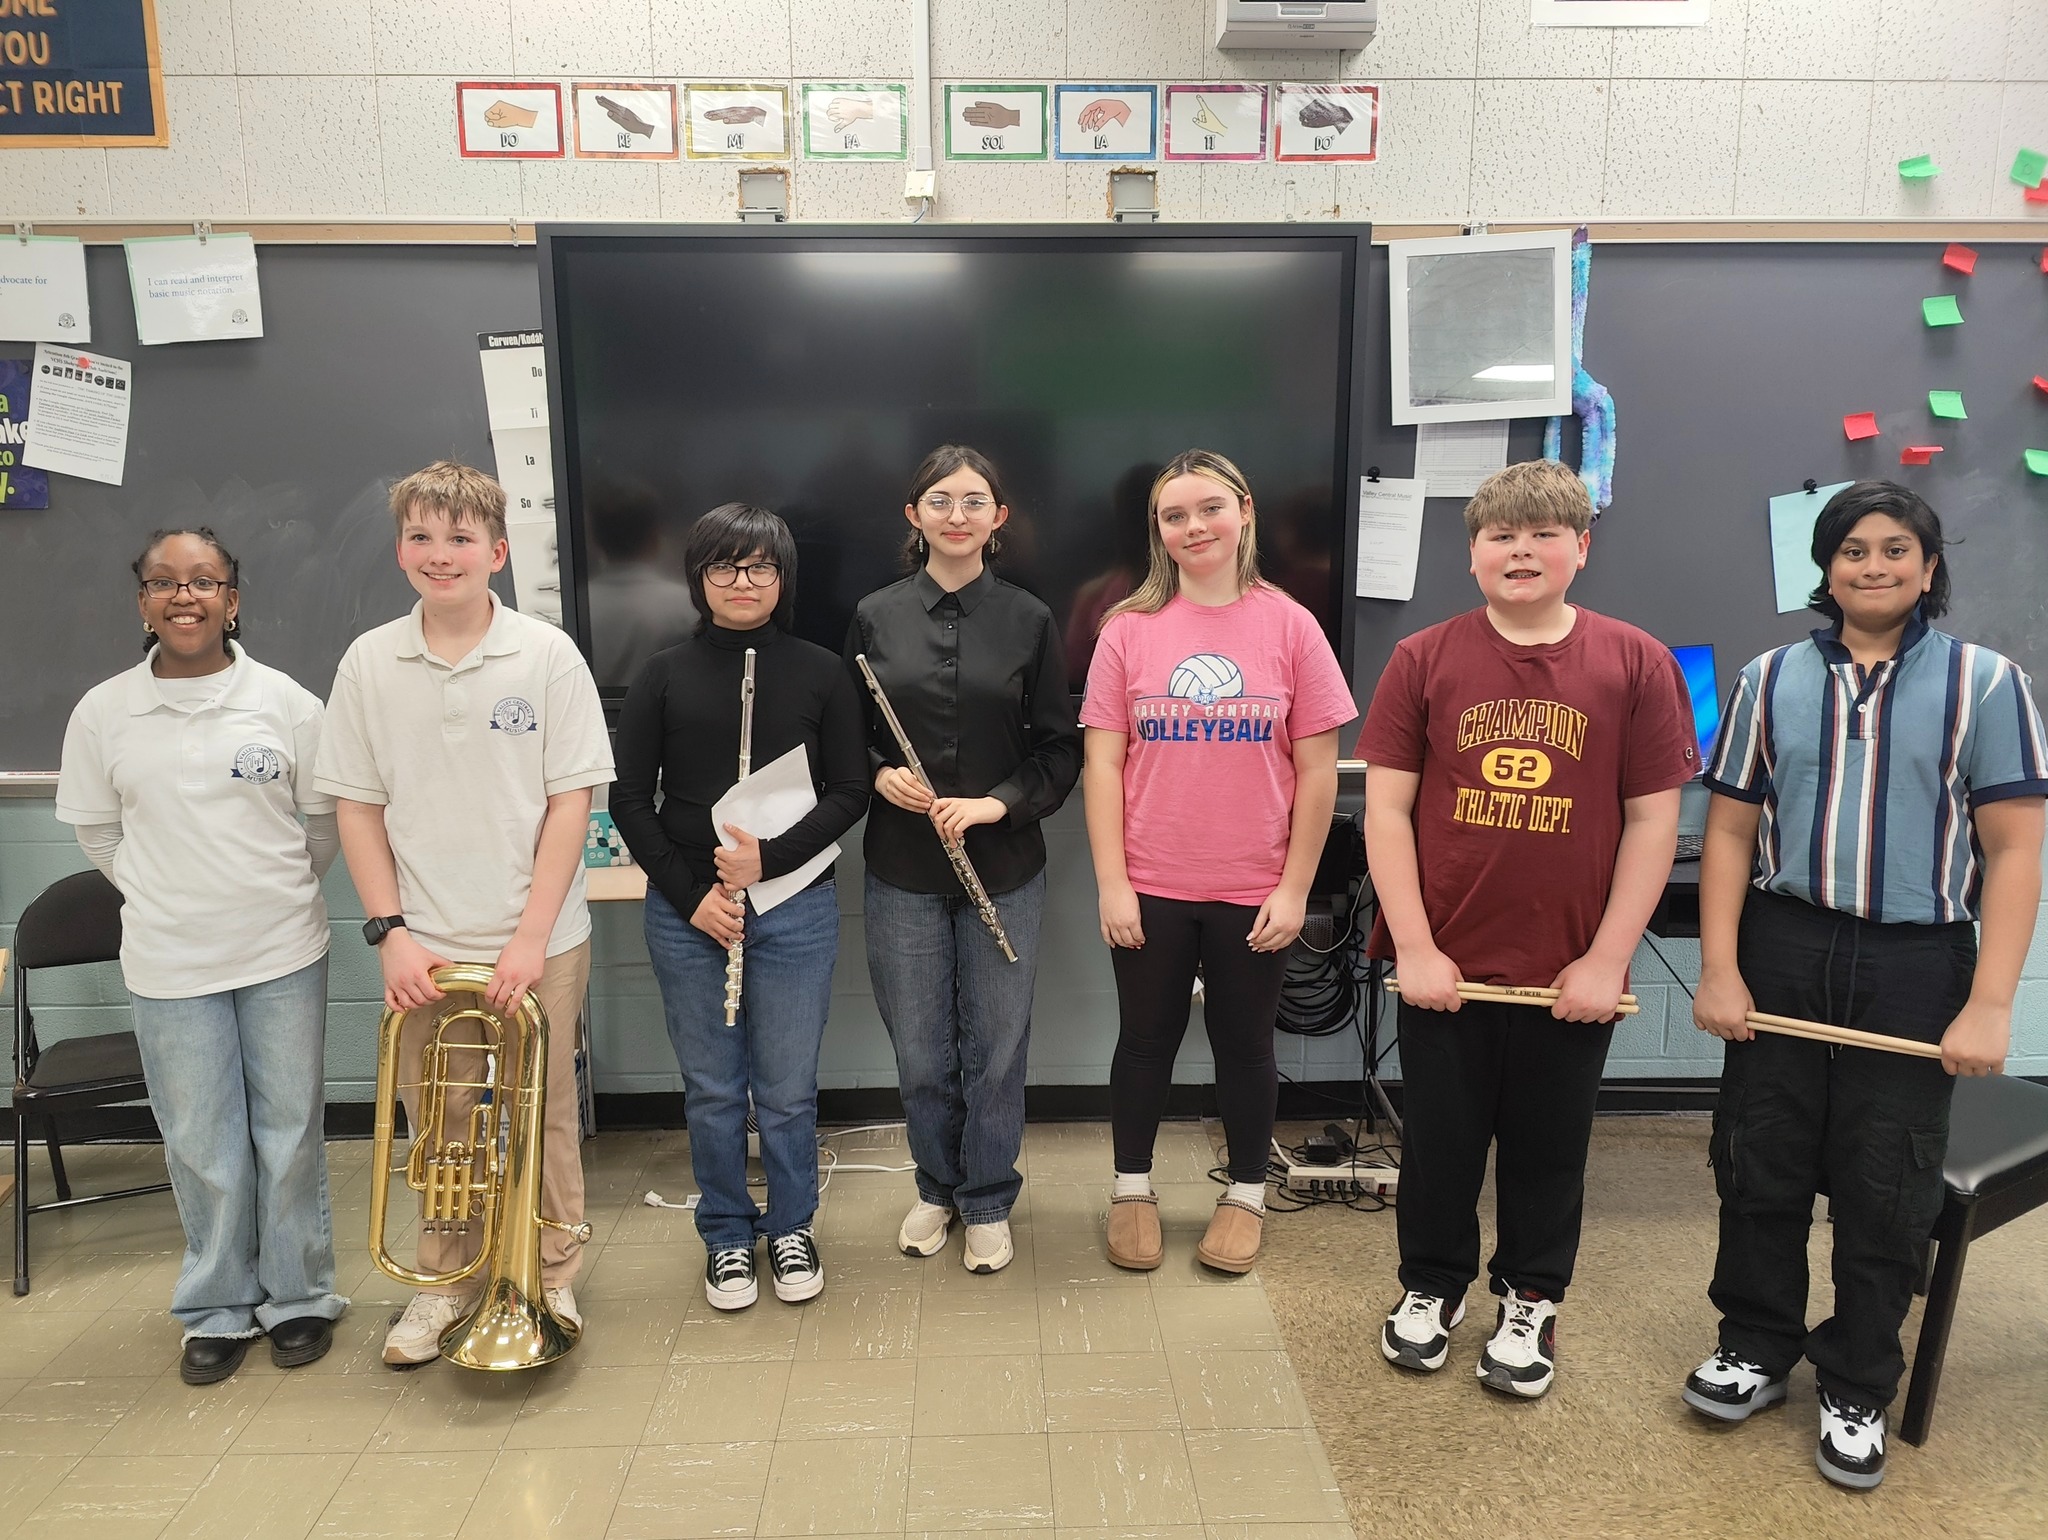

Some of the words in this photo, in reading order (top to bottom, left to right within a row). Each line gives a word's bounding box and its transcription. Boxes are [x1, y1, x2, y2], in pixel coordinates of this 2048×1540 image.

[32, 80, 124, 114] RIGHT
[500, 132, 519, 148] DO
[617, 132, 632, 149] RE
[727, 133, 744, 149] MI
[844, 134, 860, 149] FA
[1094, 135, 1109, 149] LA
[35, 275, 48, 284] for
[170, 276, 188, 285] read
[190, 275, 205, 284] and
[207, 273, 243, 284] interpret
[149, 290, 170, 298] basic
[171, 288, 195, 297] music
[531, 366, 543, 378] Do
[530, 407, 539, 419] Ti
[525, 455, 536, 466] La
[520, 497, 532, 509] So
[1134, 704, 1191, 718] VALLEY
[1205, 704, 1278, 719] CENTRAL
[1137, 718, 1273, 742] VOLLEYBALL
[1457, 699, 1588, 762] CHAMPION
[1494, 755, 1538, 782] 52
[1453, 787, 1526, 830] ATHLETIC
[1527, 795, 1573, 834] DEPT.
[1519, 990, 1541, 998] FIRTH
